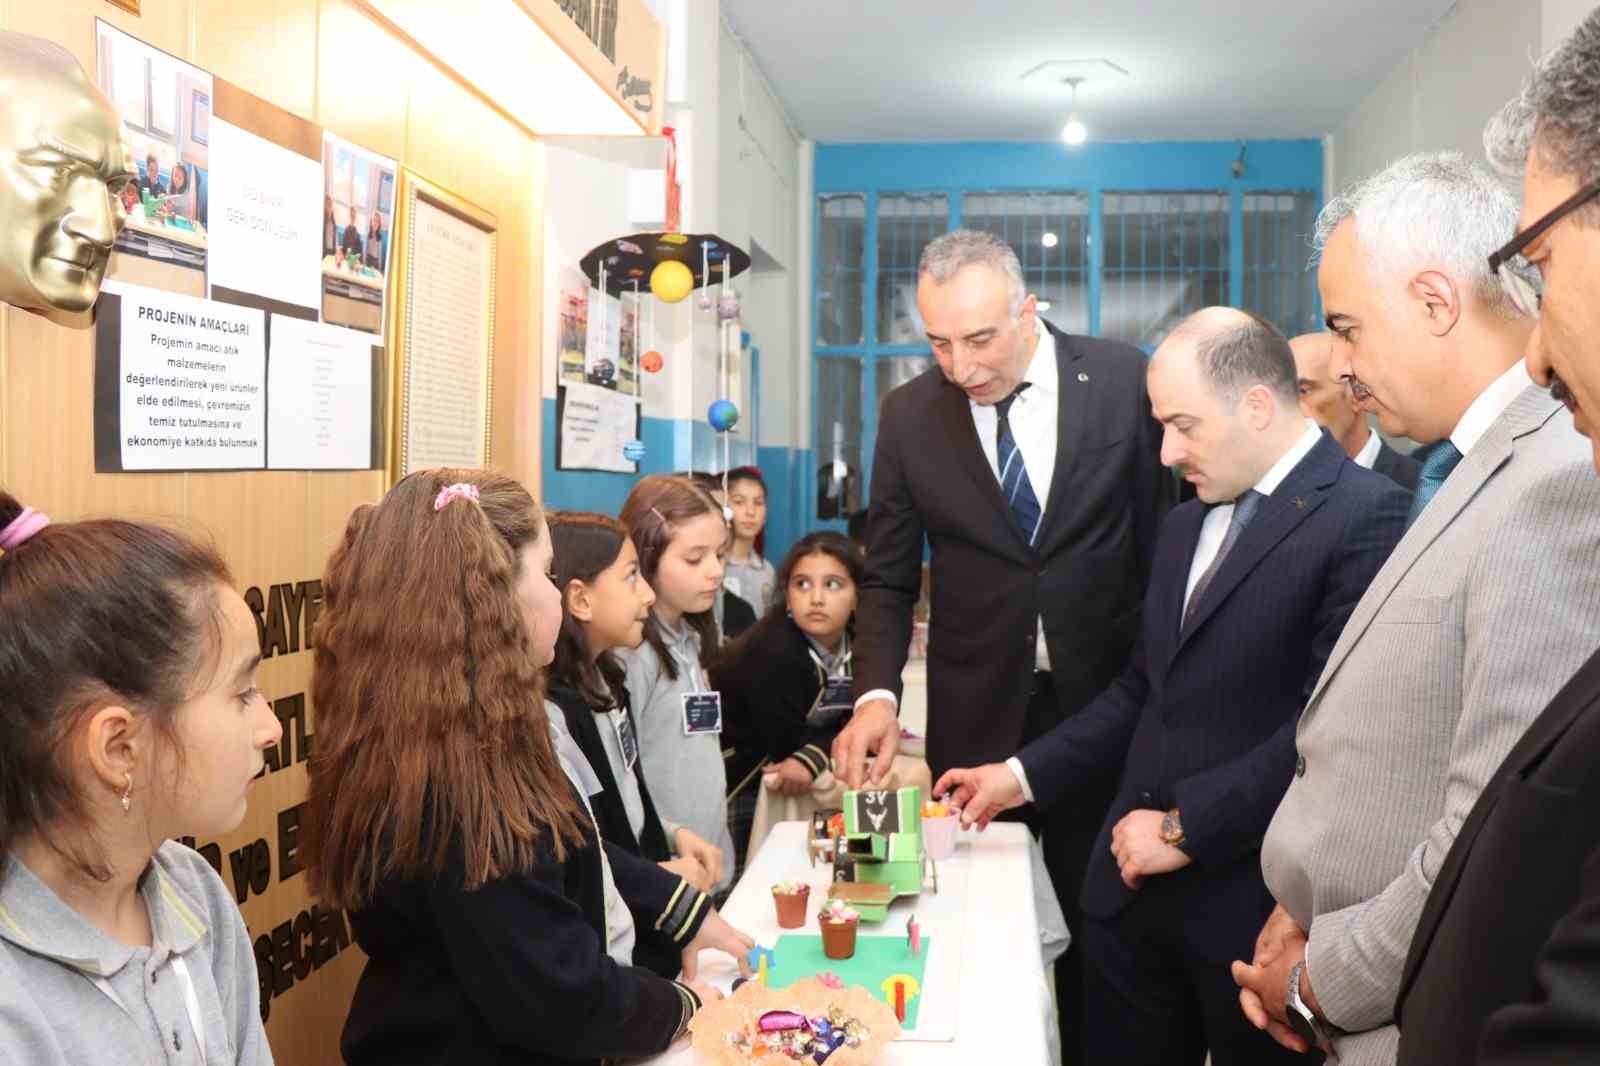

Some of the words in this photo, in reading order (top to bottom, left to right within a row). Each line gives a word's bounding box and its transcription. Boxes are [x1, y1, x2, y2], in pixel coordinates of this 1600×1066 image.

[138, 305, 197, 327] PROJENİN
[199, 316, 250, 336] AMAÇLARI
[150, 333, 193, 350] Projemin
[167, 357, 227, 373] malzemelerin
[126, 373, 208, 390] değerlendirilerek
[136, 395, 159, 406] elde
[148, 416, 177, 427] temiz
[127, 435, 182, 450] ekonomiye
[218, 437, 258, 448] bulunmak
[244, 580, 322, 660] SAYE
